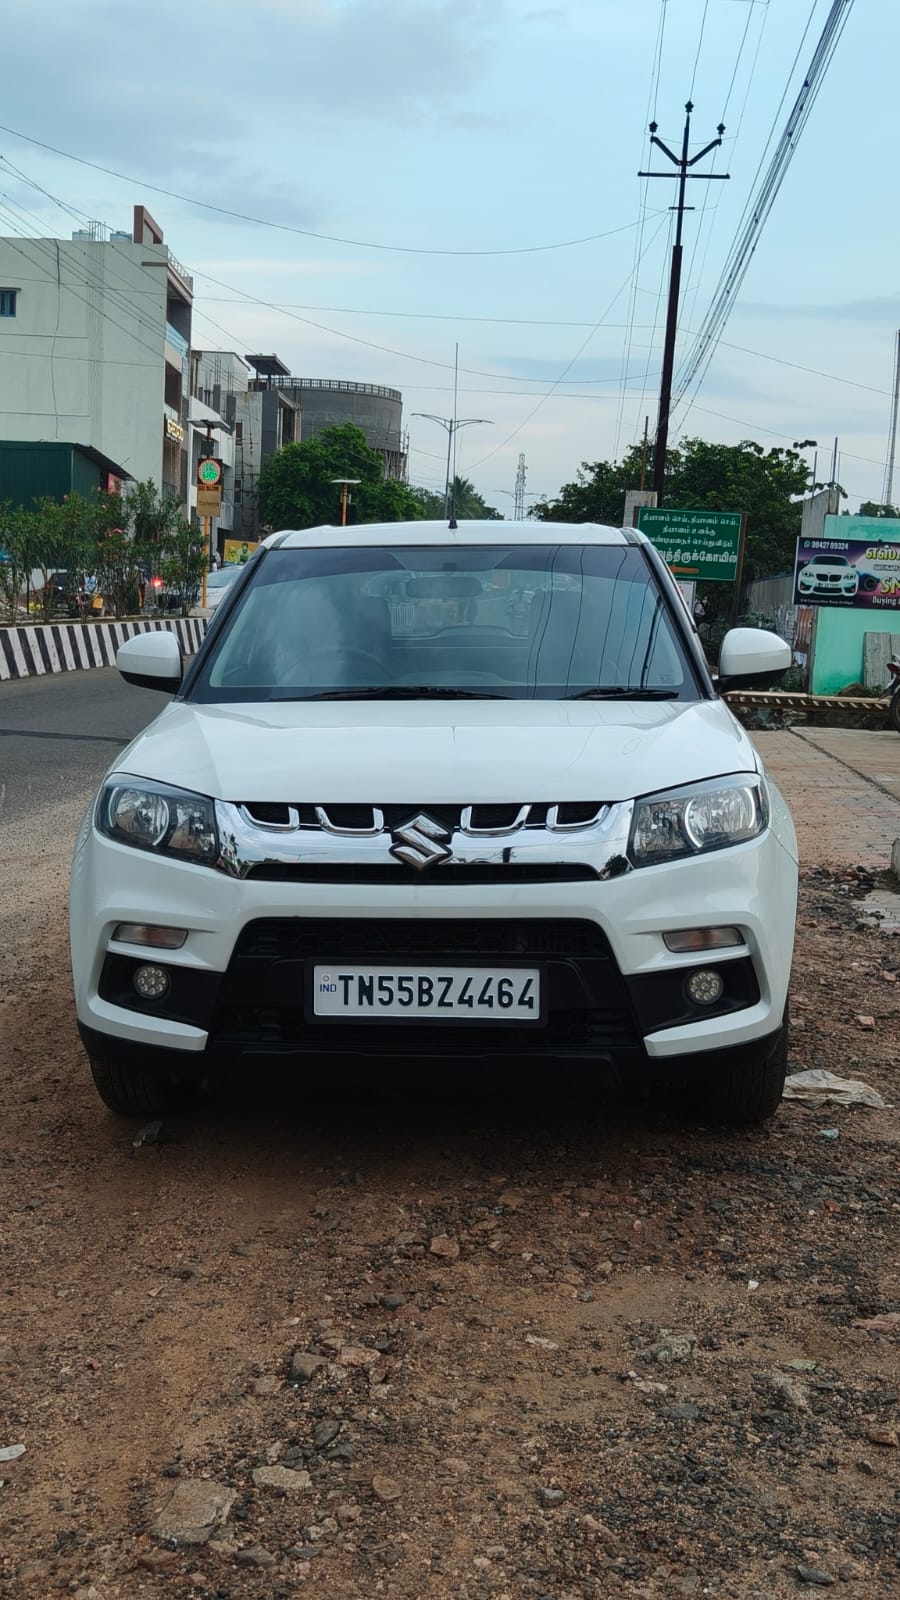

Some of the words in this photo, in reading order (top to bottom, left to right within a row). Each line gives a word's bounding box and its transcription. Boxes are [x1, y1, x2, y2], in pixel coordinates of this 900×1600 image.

[872, 596, 897, 606] Buying
[319, 983, 337, 993] IND
[338, 974, 534, 1010] TN55BZ4464
